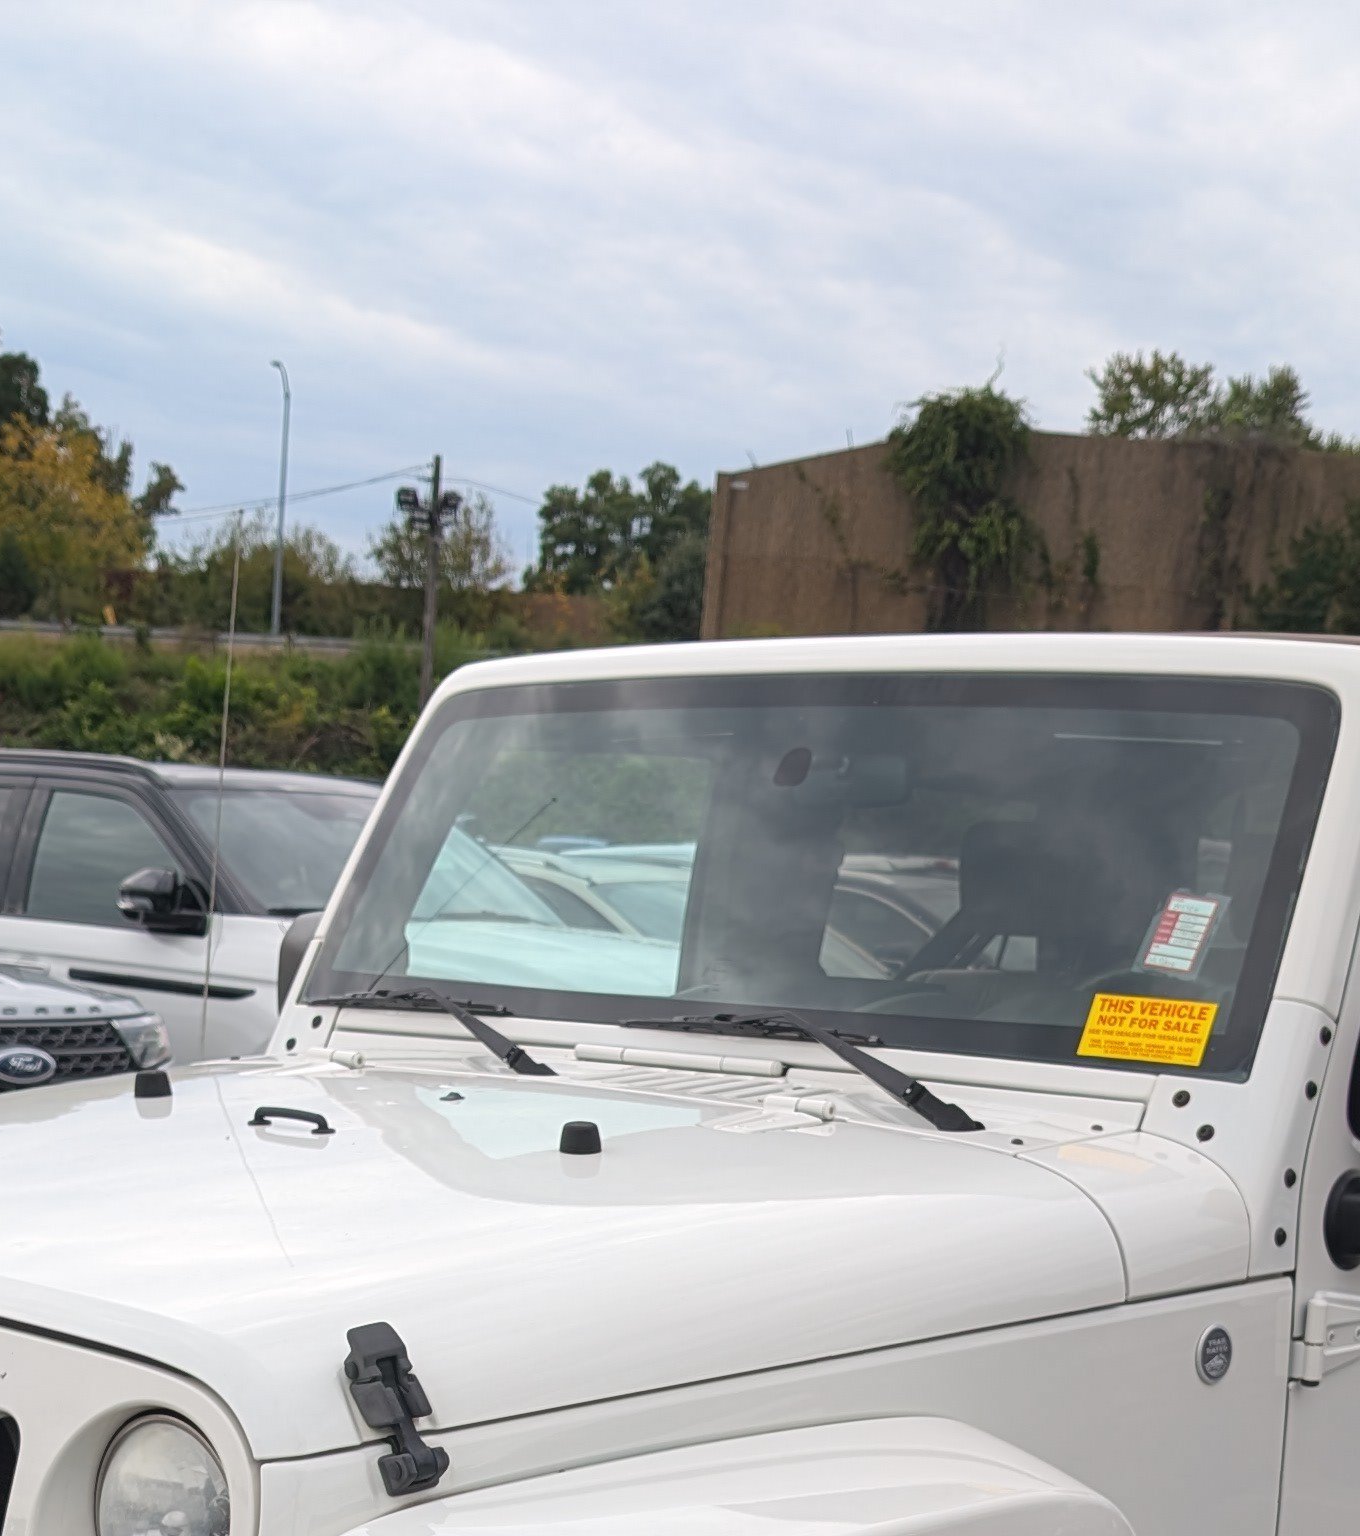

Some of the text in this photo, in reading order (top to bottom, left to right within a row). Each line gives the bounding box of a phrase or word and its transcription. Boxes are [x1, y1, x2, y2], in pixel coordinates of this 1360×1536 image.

[1099, 998, 1210, 1021] THIS VEHICLE
[1097, 1015, 1201, 1034] NOT FOR SALE
[8, 1056, 43, 1072] Ford
